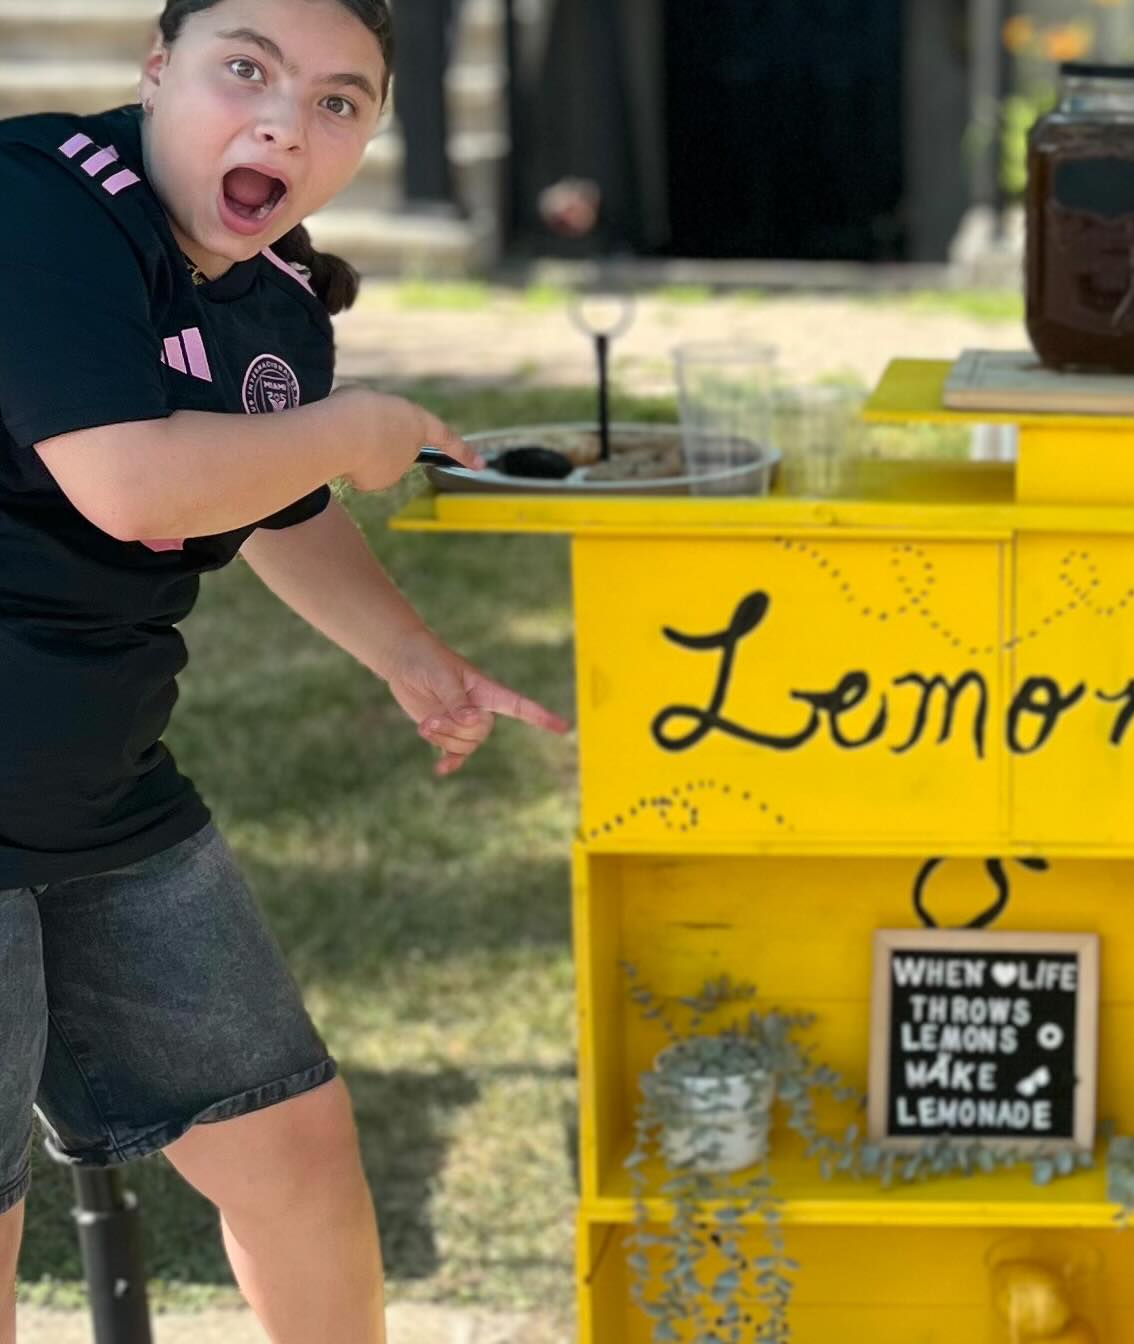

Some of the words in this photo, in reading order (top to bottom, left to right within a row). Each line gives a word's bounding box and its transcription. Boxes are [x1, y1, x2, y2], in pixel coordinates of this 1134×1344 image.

[892, 957, 986, 988] WHEN
[1018, 960, 1078, 991] LIFE
[910, 994, 1031, 1027] THROWS
[900, 1022, 1018, 1053] LEMONS
[896, 1096, 1052, 1130] LEMONADE
